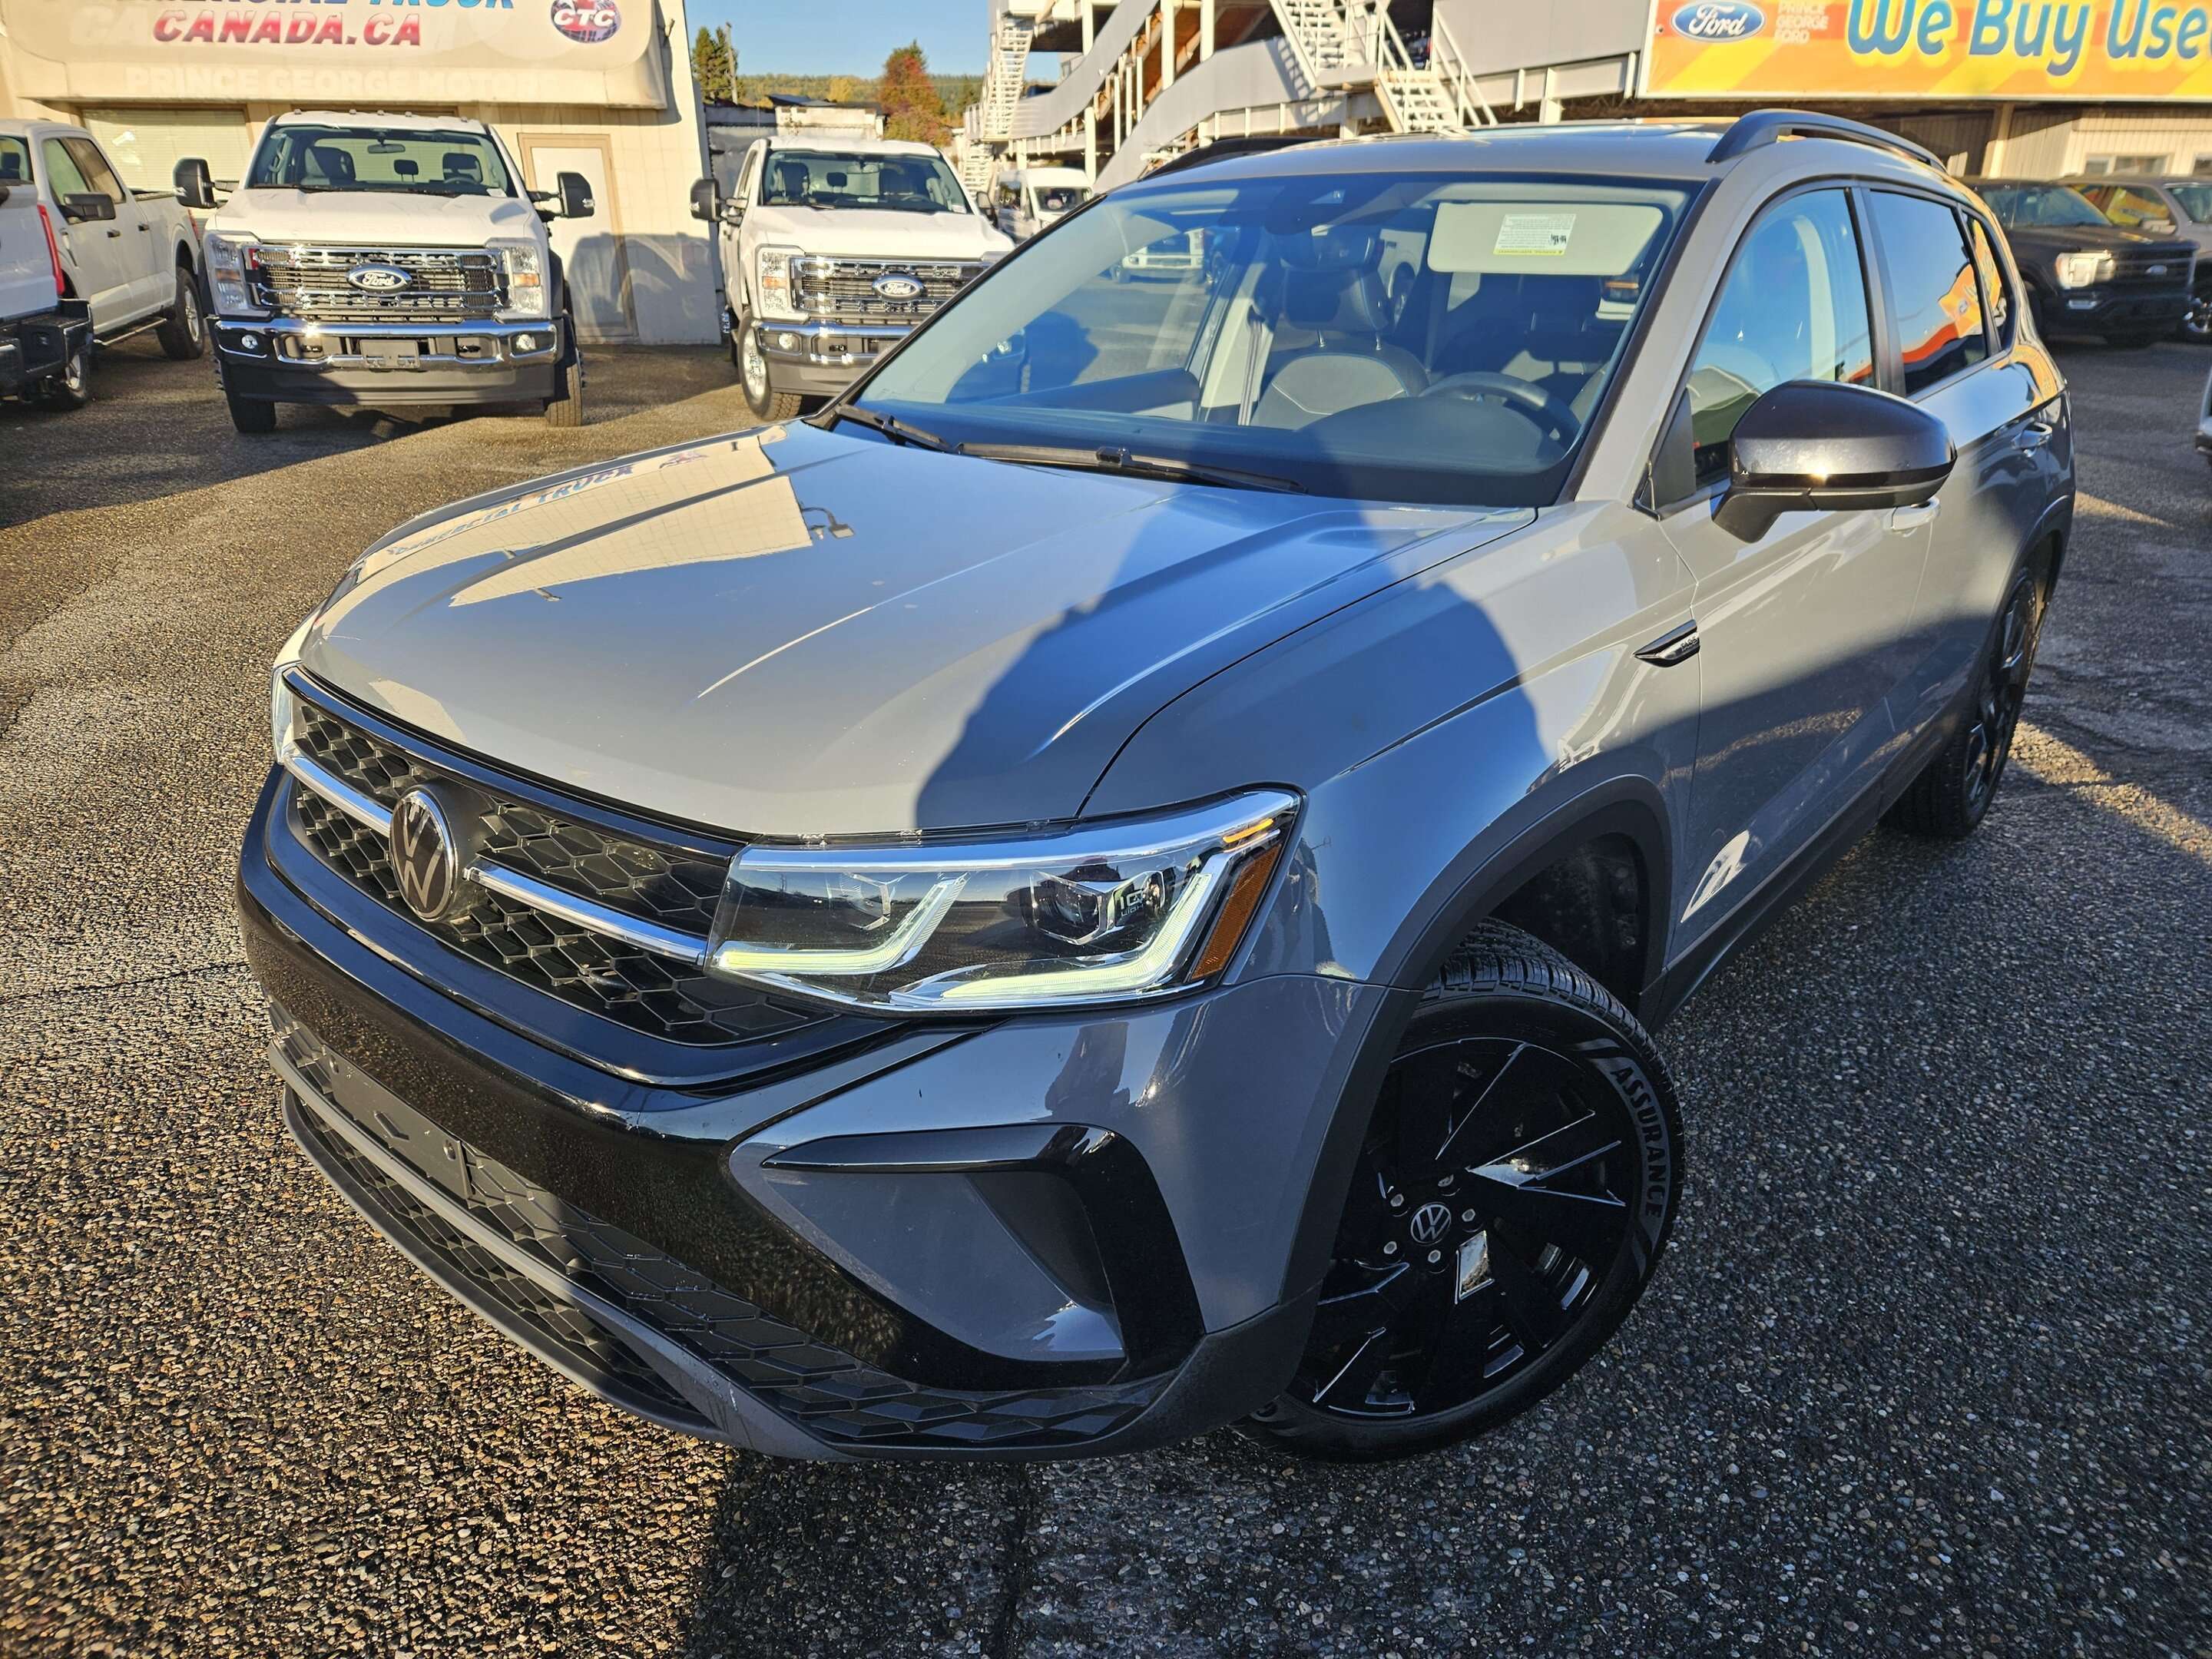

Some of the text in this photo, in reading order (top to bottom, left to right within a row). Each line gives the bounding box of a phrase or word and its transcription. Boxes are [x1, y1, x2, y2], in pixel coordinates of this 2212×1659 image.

[154, 10, 421, 46] CANADA.CA
[553, 9, 616, 27] CTC
[1688, 5, 1748, 36] Ford
[1776, 15, 1828, 29] GEORGE
[1774, 29, 1810, 44] FORD
[1848, 0, 2212, 76] We Buy Use
[125, 67, 259, 94] PRINCE
[362, 272, 395, 286] Ford
[885, 282, 912, 295] Ford
[1610, 1067, 1667, 1218] ASSURANCE
[1413, 1205, 1451, 1242] VW
